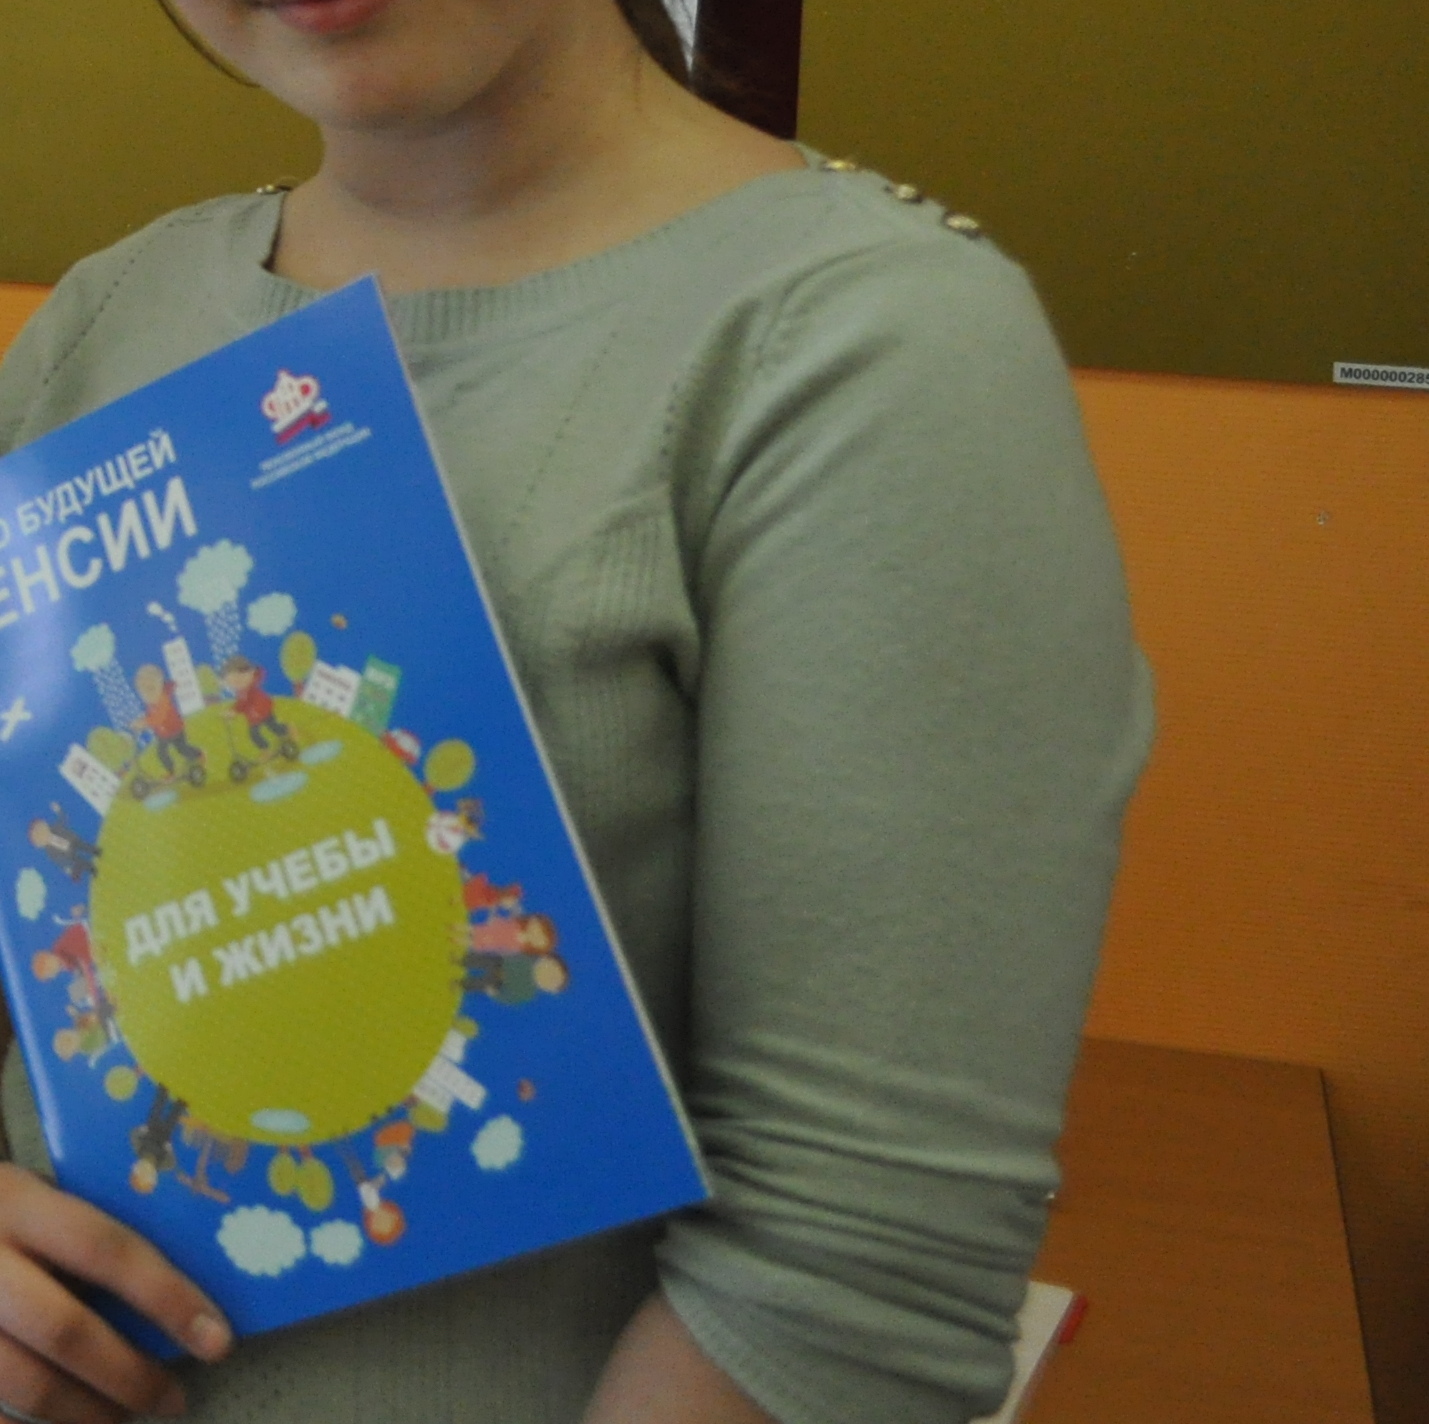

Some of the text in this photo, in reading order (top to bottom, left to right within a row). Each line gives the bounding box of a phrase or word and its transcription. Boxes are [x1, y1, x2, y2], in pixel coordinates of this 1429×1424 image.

[17, 428, 178, 537] БУДУЩЕЙ
[122, 817, 398, 966] ДЛЯ УЧЕБЫ
[169, 884, 397, 1004] И ЖИЗНИ
